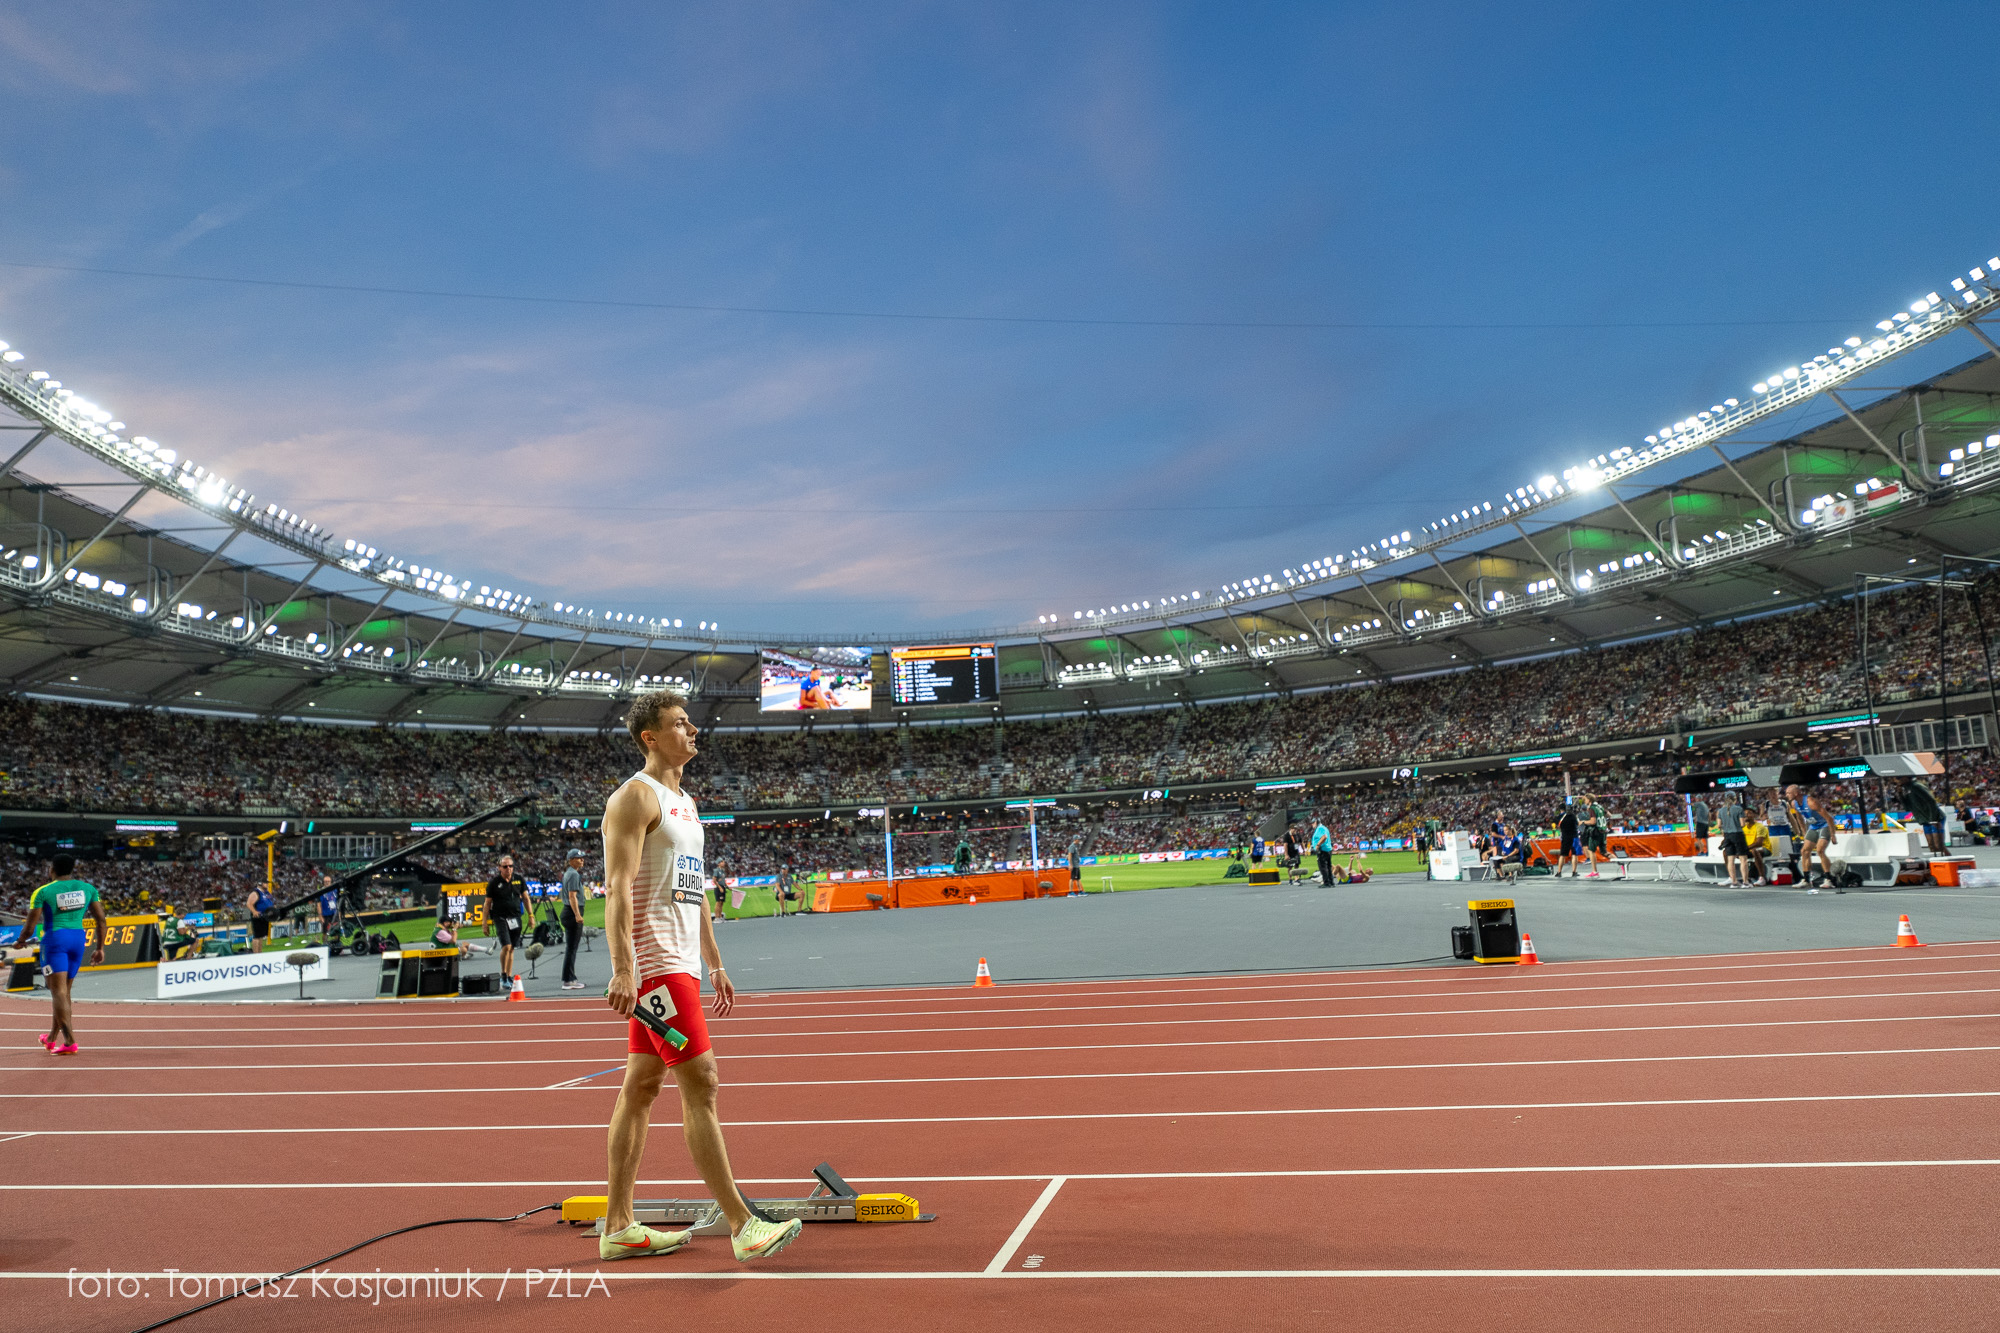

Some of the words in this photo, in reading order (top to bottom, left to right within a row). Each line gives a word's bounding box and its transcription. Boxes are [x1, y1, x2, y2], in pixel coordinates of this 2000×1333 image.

[678, 872, 703, 892] BURDA
[66, 891, 82, 899] TDK
[64, 898, 80, 906] BRA
[1480, 901, 1508, 909] SEIKO
[165, 928, 177, 939] 12
[45, 967, 51, 975] 4
[649, 994, 666, 1018] 8
[861, 1204, 906, 1216] SEIKO
